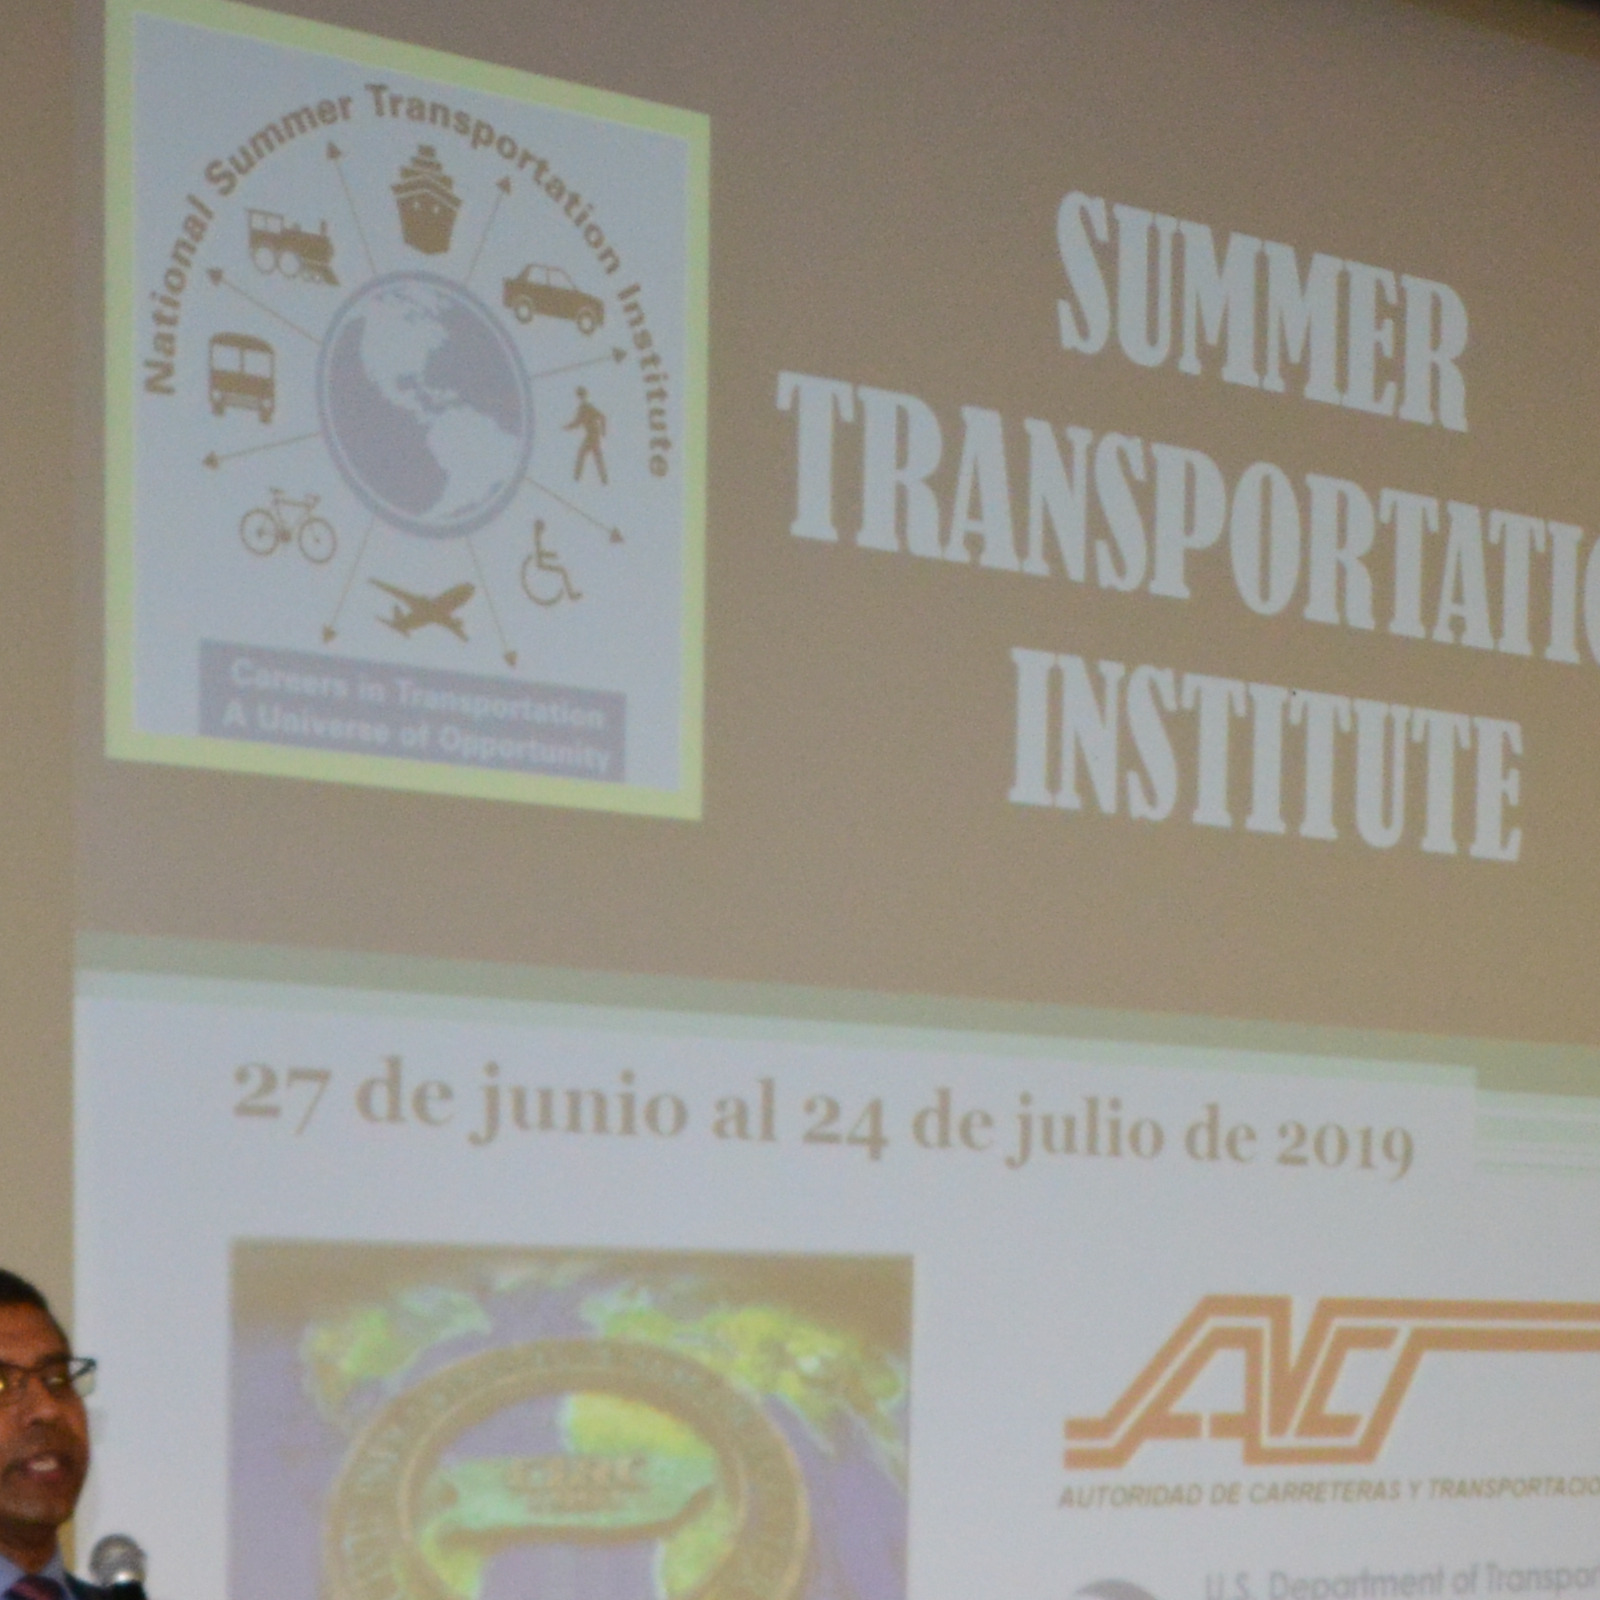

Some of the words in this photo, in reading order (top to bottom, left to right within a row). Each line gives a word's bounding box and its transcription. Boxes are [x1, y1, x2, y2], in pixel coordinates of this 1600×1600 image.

[143, 193, 215, 397] National
[204, 95, 354, 196] Summer
[365, 83, 621, 275] Transportation
[617, 283, 670, 478] Institute
[1055, 190, 1469, 432] SUMMER
[222, 702, 249, 729] A
[258, 703, 390, 747] Universe
[401, 723, 429, 748] of
[439, 726, 610, 773] Opportunity
[231, 657, 348, 699] Careers
[358, 678, 386, 702] in
[395, 681, 605, 729] Transportation
[1007, 647, 1524, 862] INSTITUTE
[231, 1062, 334, 1136] 27
[354, 1058, 455, 1128] de
[468, 1060, 689, 1148] junio
[711, 1078, 778, 1144] al
[801, 1092, 890, 1163] 24
[911, 1086, 996, 1153] de
[1004, 1093, 1166, 1169] julio
[1183, 1101, 1258, 1165] de
[1275, 1118, 1416, 1181] 2019
[1058, 1484, 1202, 1509] AUTORIDAD
[1210, 1483, 1242, 1507] DE
[1250, 1480, 1403, 1505] CARRETERAS
[1408, 1480, 1422, 1500] Y
[1451, 1562, 1481, 1596] of
